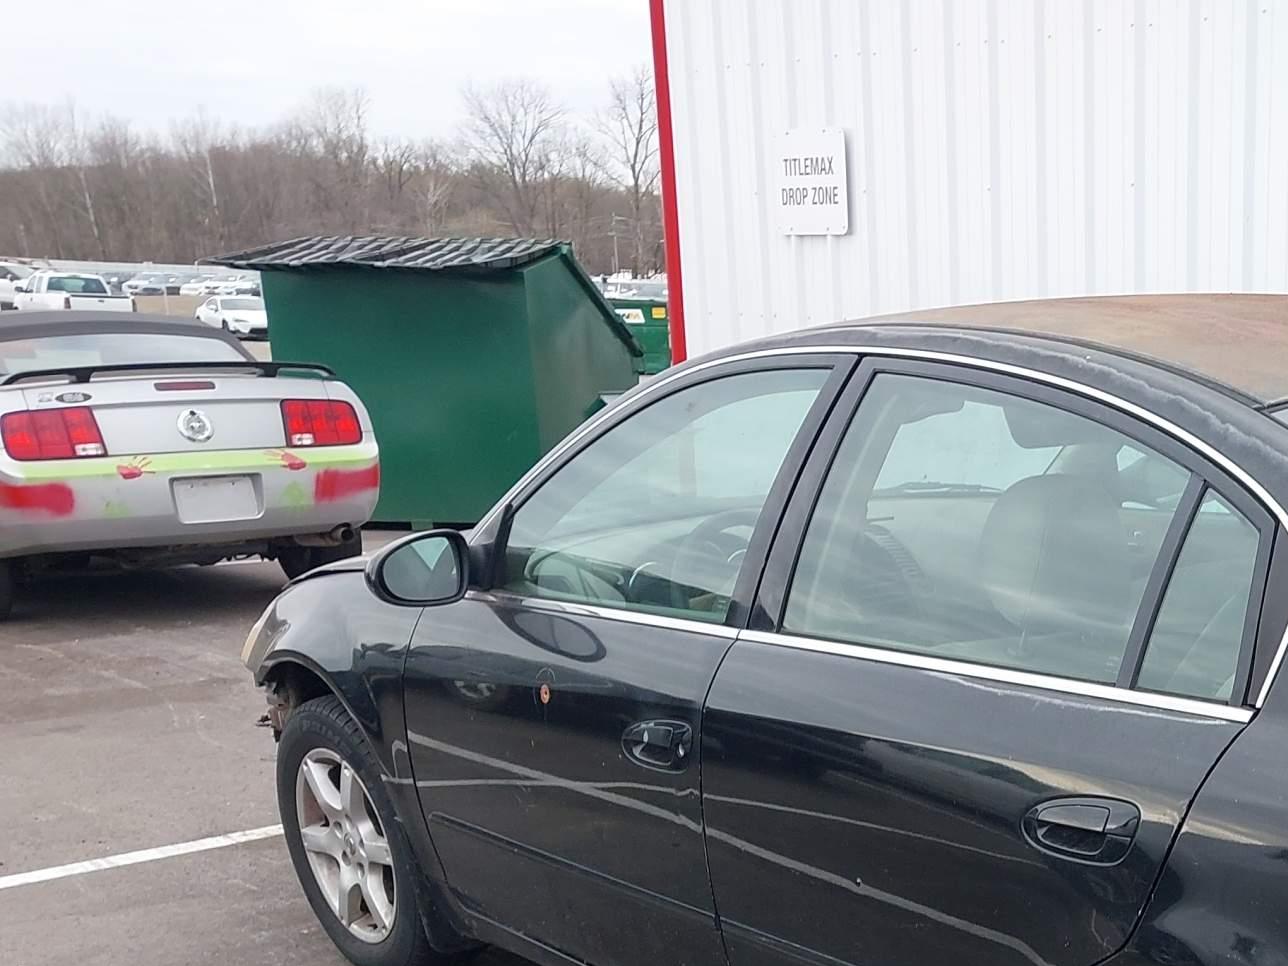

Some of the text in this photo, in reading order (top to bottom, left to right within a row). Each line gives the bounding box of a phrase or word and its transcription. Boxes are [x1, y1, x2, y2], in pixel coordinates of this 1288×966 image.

[783, 156, 834, 176] TITLEMAX
[781, 186, 839, 206] DROP ZONE
